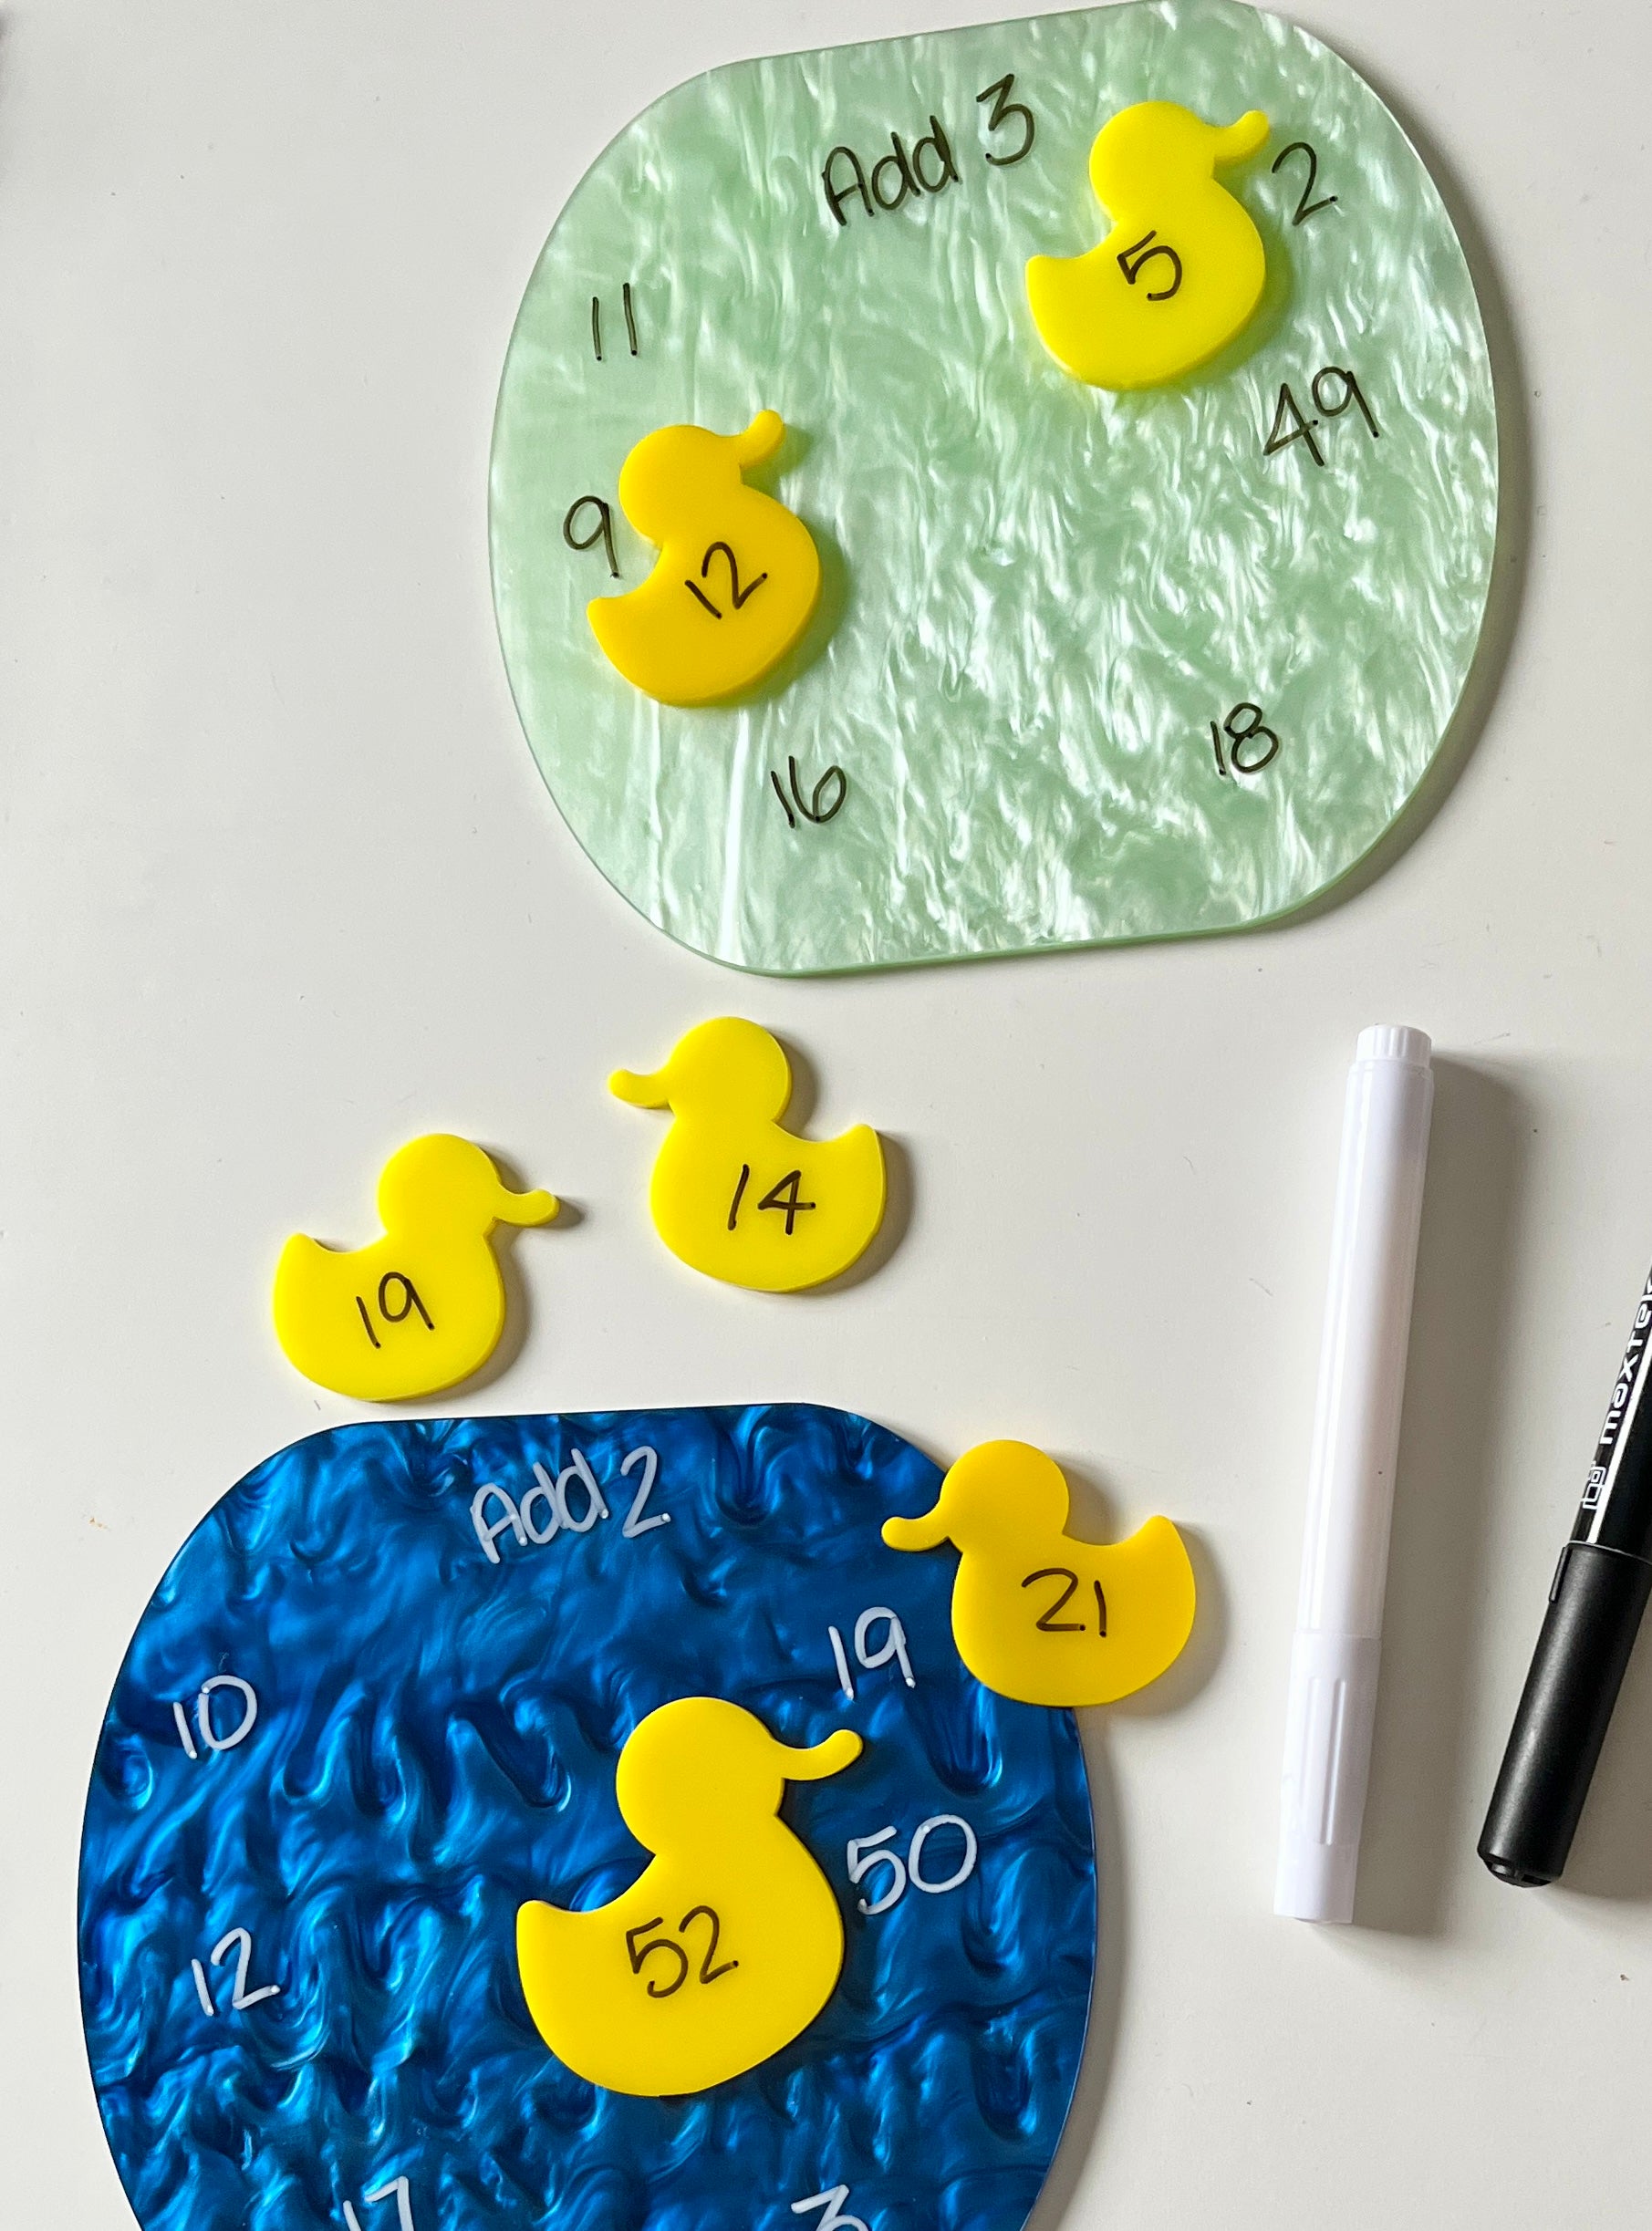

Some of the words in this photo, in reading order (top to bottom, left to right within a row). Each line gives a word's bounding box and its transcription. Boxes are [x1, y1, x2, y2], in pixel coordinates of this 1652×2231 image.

[822, 115, 959, 226] Add
[976, 73, 1035, 166] 3
[1272, 141, 1338, 226] 2
[1117, 230, 1183, 301] 5
[591, 282, 639, 361] 11
[1263, 366, 1380, 467] 49
[563, 495, 620, 579] 9
[684, 541, 768, 620] 12
[1210, 702, 1279, 775] 18
[770, 755, 847, 829] 16
[726, 1163, 816, 1236] 14
[355, 1271, 435, 1350] 19
[470, 1448, 609, 1564] Add
[620, 1446, 671, 1539] 2
[1021, 1567, 1108, 1638] 21
[827, 1606, 917, 1702] 19
[172, 1675, 258, 1759] 10
[847, 1813, 978, 1915] 50
[191, 1927, 281, 2017] 12
[626, 1904, 740, 1999] 52
